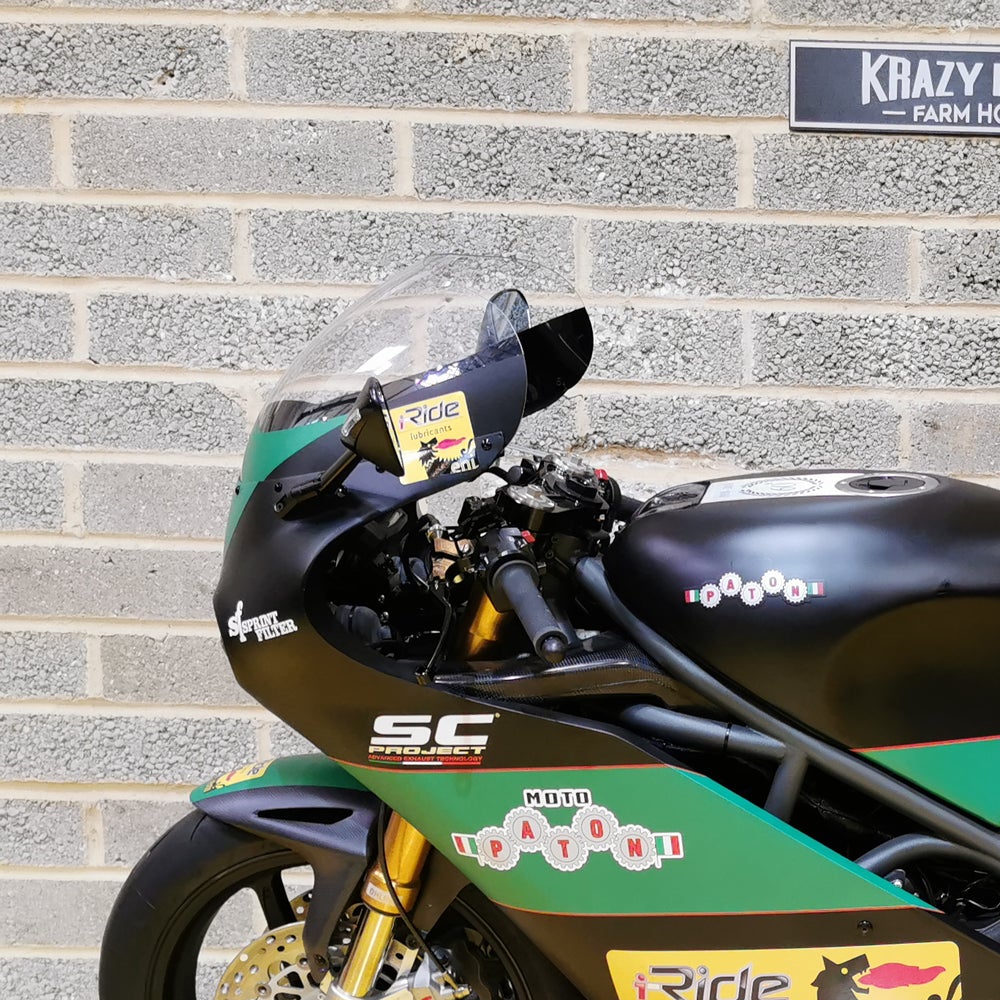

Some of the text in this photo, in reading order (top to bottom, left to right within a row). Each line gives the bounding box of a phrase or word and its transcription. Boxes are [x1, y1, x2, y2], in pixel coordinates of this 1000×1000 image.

[862, 51, 984, 106] KRAZY
[913, 103, 970, 124] FARM
[410, 425, 452, 440] lubricants
[706, 576, 800, 602] PATON
[242, 611, 279, 634] SPRINT
[255, 619, 298, 642] FILTER
[370, 714, 494, 746] SC
[369, 746, 486, 755] PROJECT
[403, 754, 435, 762] EXHAUST
[436, 754, 483, 762] TECHNOLOGY
[526, 792, 589, 804] MOTO
[490, 818, 644, 858] PATON
